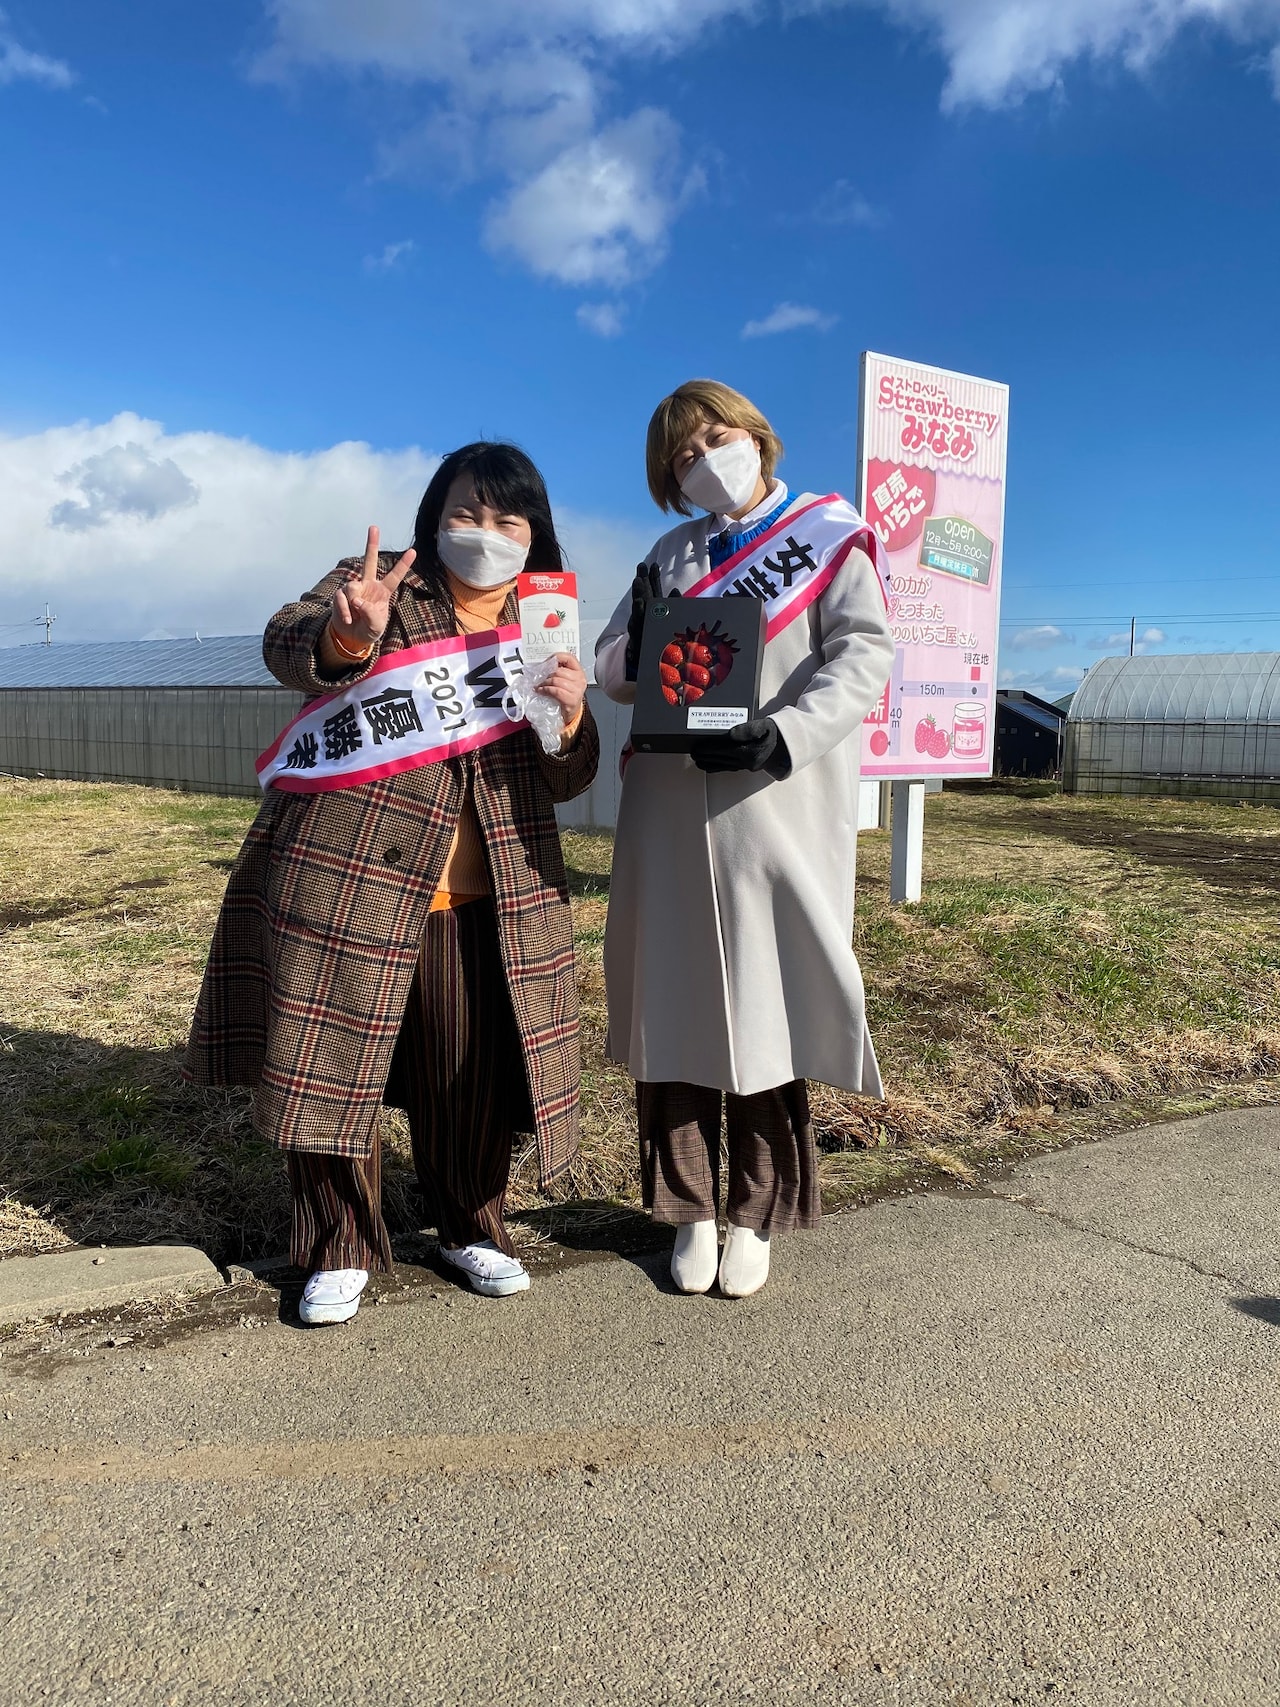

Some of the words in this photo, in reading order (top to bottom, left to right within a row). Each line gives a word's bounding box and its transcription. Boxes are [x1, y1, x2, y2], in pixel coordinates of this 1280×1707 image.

[895, 377, 946, 397] ストロベリー
[878, 375, 998, 433] Strawberry
[901, 414, 975, 459] みなみ
[872, 468, 908, 513] 直売
[874, 487, 927, 544] いちご
[889, 575, 930, 595] の力が
[526, 630, 576, 645] DAICHI
[964, 652, 989, 665] 現在地
[424, 666, 468, 732] 2021
[919, 684, 945, 696] 150m
[277, 686, 425, 771] 優勝者
[889, 707, 902, 719] 40
